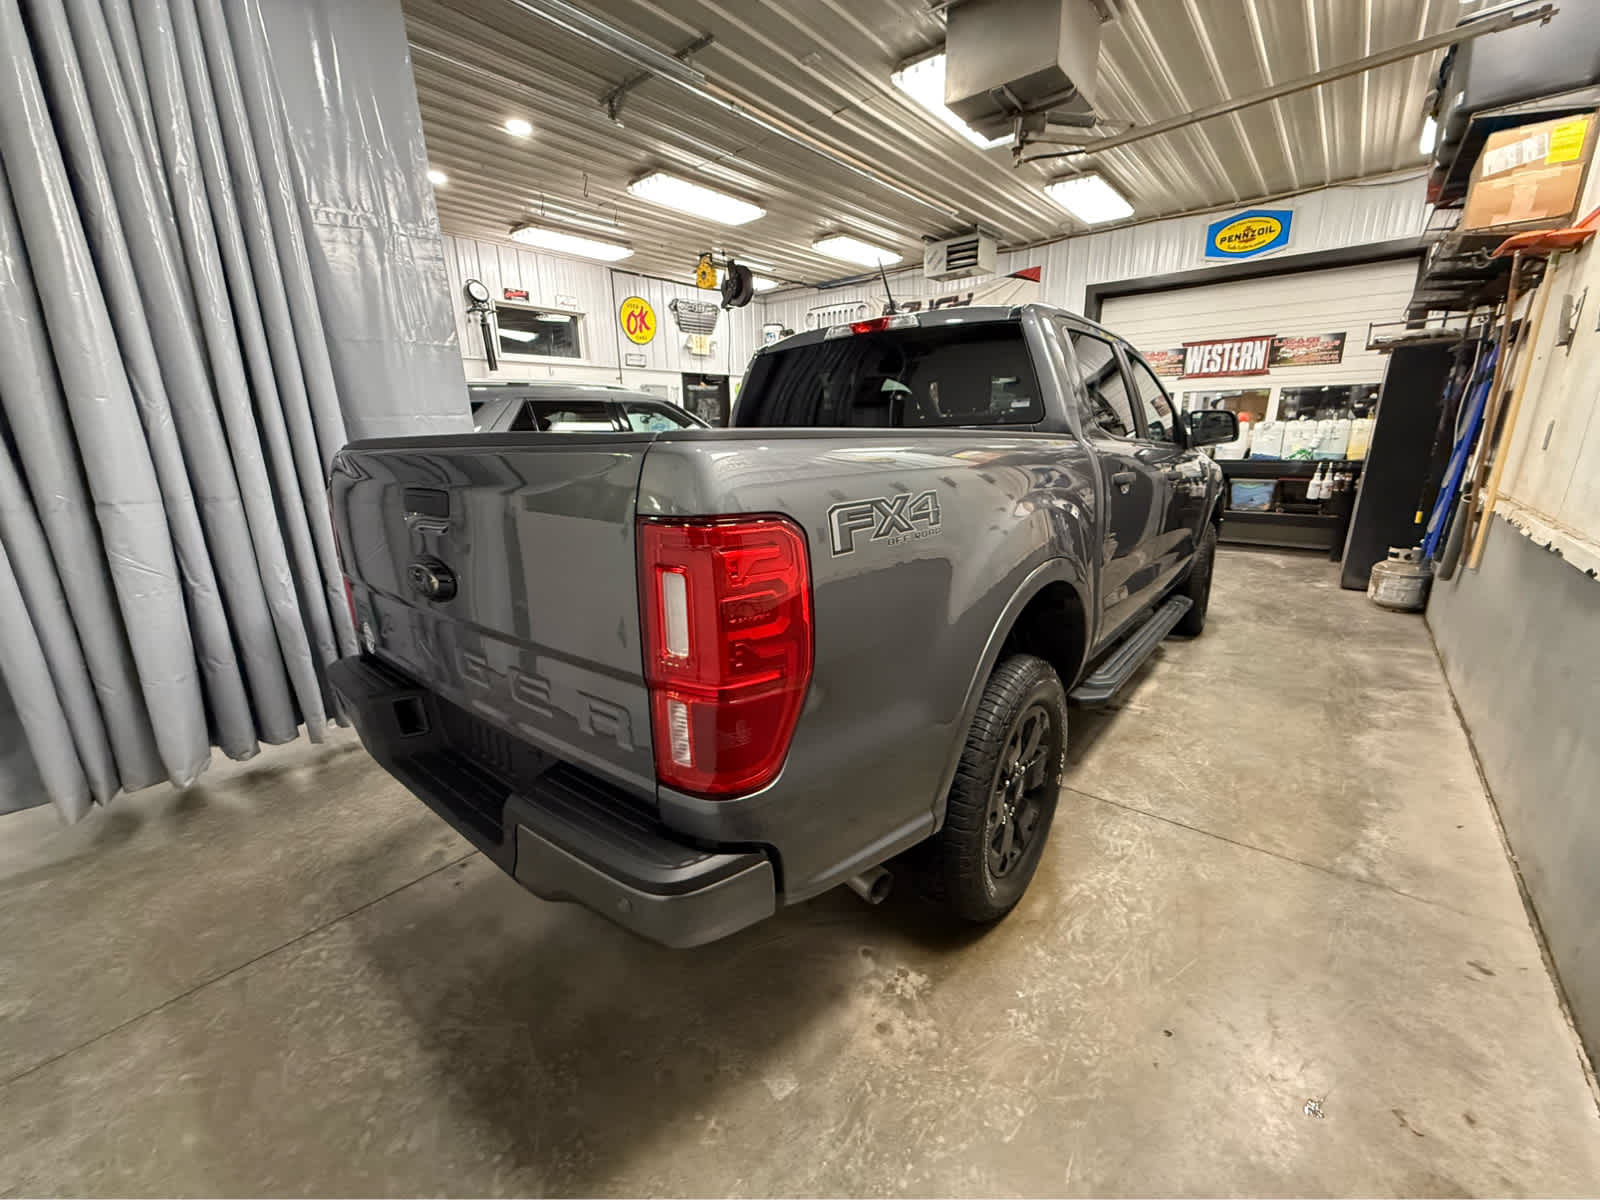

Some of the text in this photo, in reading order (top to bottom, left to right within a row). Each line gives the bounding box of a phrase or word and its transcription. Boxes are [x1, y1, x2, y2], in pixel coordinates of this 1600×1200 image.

[1219, 225, 1275, 245] PENNZOIL
[627, 305, 651, 335] OK
[1185, 340, 1267, 374] WESTERN
[826, 489, 941, 558] FX4
